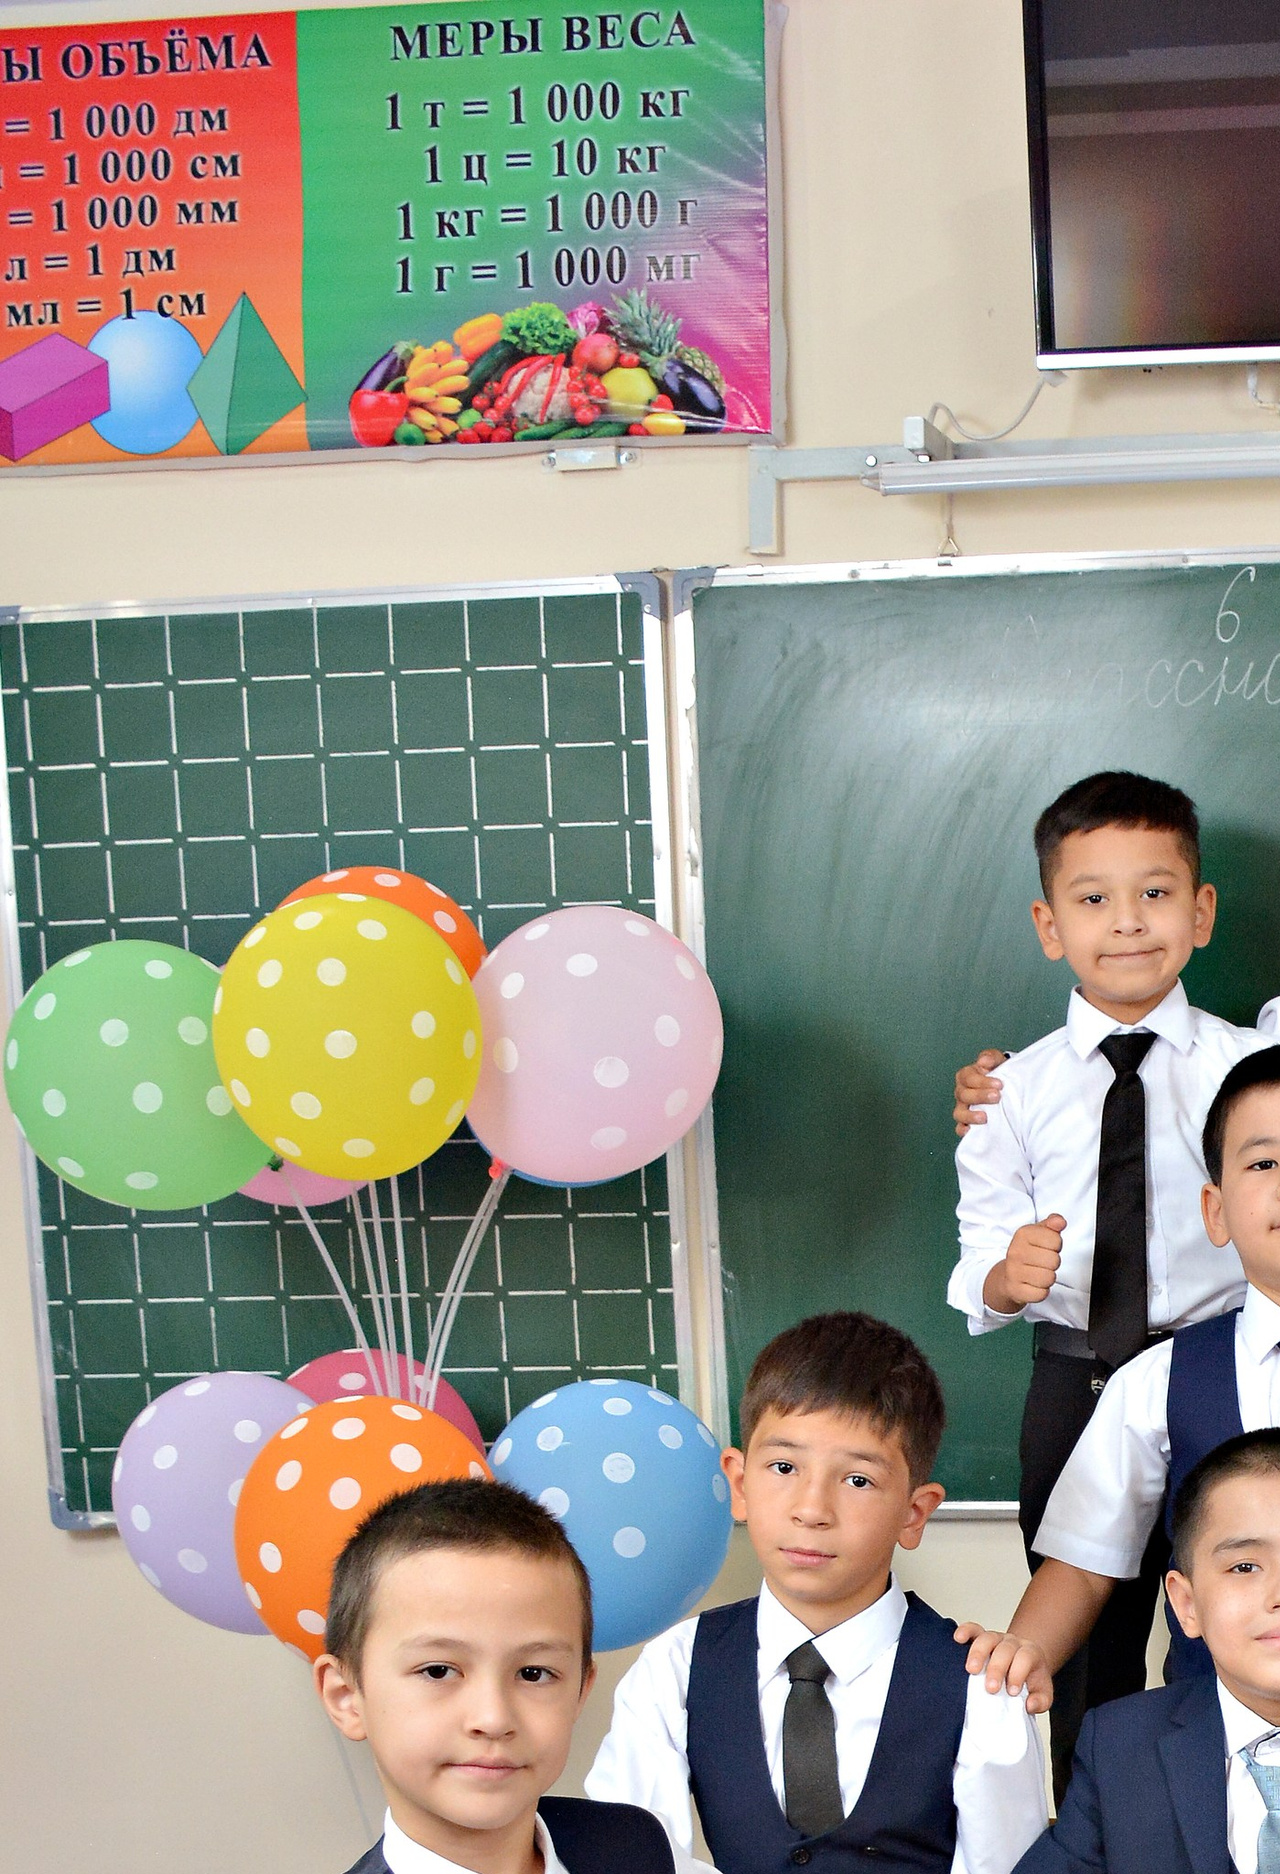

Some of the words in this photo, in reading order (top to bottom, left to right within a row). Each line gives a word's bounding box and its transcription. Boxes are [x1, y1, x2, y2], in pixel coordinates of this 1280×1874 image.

[61, 28, 272, 79] ОБЪЁМА
[389, 17, 543, 61] МЕРЫ
[562, 10, 696, 52] ВЕСА
[5, 120, 30, 133] =
[48, 108, 65, 140] 1
[86, 102, 155, 138] 000
[173, 108, 228, 138] дм
[386, 92, 403, 130] 1
[423, 101, 446, 128] т
[463, 100, 489, 115] =
[508, 86, 527, 125] 1
[547, 81, 620, 123] 000
[640, 90, 689, 118] кг
[20, 165, 44, 177] =
[64, 153, 79, 185] 1
[101, 148, 171, 183] 000
[190, 153, 241, 179] см
[424, 145, 442, 184] 1
[463, 154, 488, 186] ц
[506, 153, 531, 167] =
[551, 138, 597, 177] 10
[617, 145, 666, 175] кг
[8, 211, 33, 225] =
[52, 199, 68, 232] 1
[88, 194, 157, 229] 000
[177, 200, 239, 225] мм
[397, 201, 415, 240] 1
[435, 209, 484, 238] кг
[501, 208, 526, 222] =
[547, 194, 563, 232] 1
[585, 189, 658, 231] 000
[677, 199, 697, 226] г
[5, 257, 28, 281] л
[44, 255, 68, 268] =
[86, 243, 103, 276] 1
[122, 248, 176, 278] дм
[396, 256, 413, 293] 1
[435, 266, 455, 292] г
[472, 265, 497, 279] =
[516, 250, 534, 289] 1
[555, 246, 627, 287] 000
[646, 254, 700, 282] мг
[7, 301, 60, 327] мл
[77, 299, 101, 313] =
[120, 287, 136, 320] 1
[157, 292, 206, 318] см
[1216, 566, 1255, 642] 6
